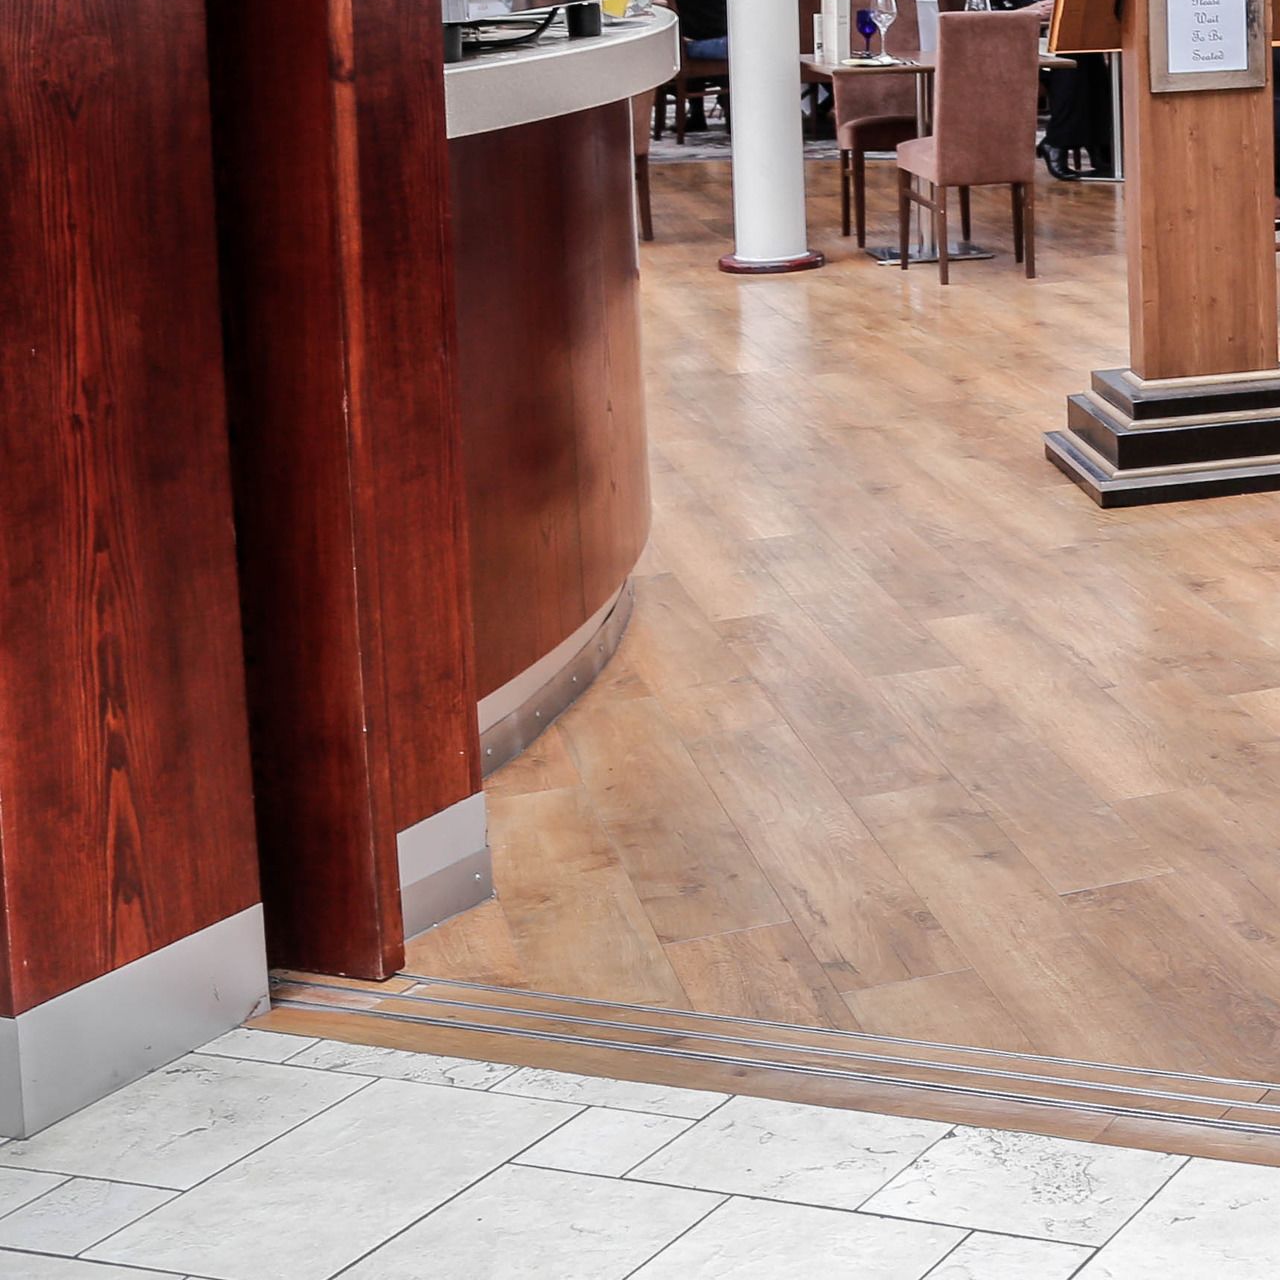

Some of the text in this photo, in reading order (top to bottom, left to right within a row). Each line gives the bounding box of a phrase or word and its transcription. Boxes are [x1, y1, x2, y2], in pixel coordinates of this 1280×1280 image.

[1194, 12, 1219, 24] Wait
[1191, 29, 1223, 43] To Be
[1191, 49, 1224, 62] Seated
